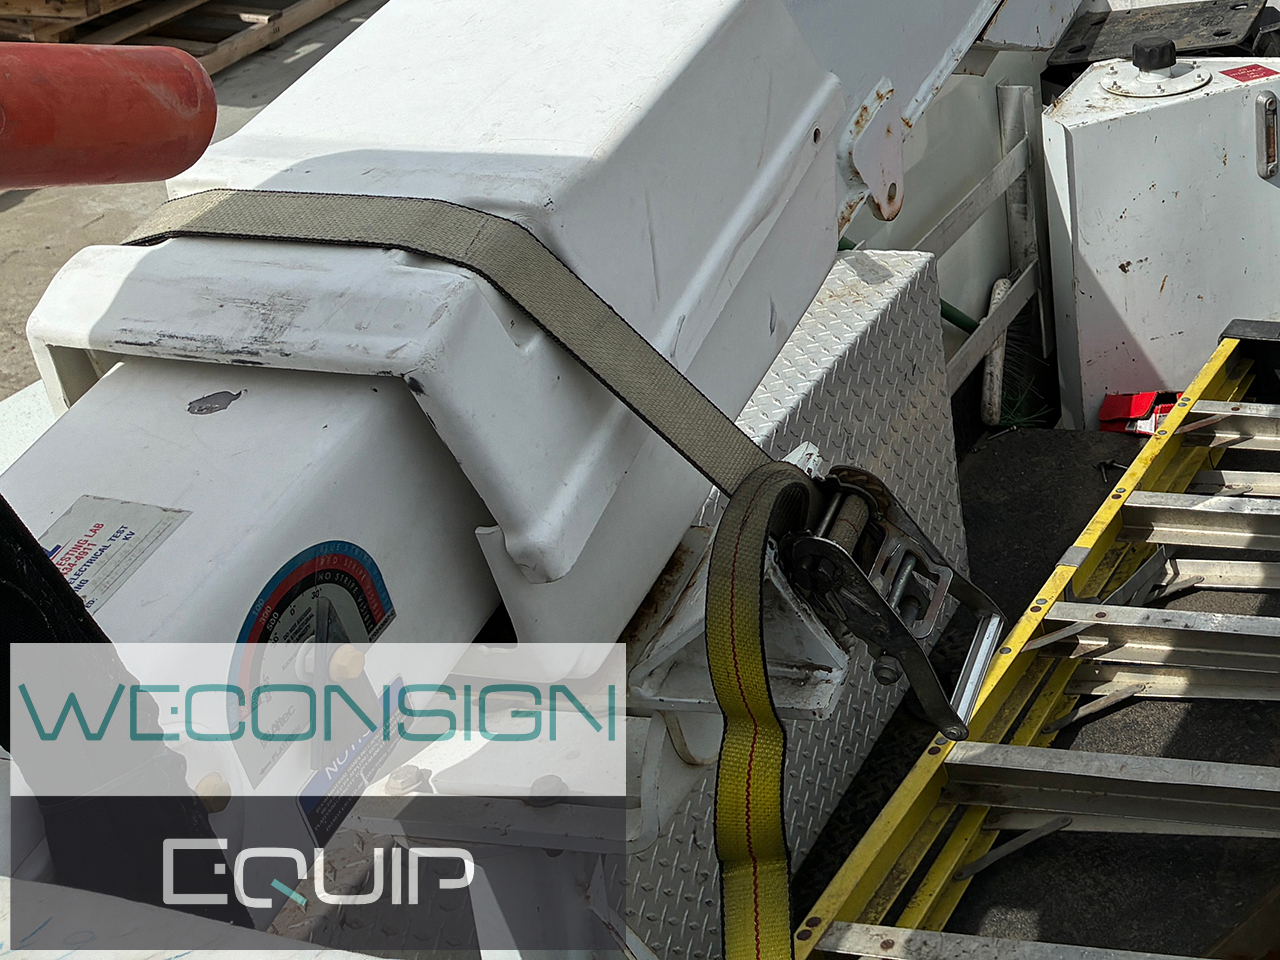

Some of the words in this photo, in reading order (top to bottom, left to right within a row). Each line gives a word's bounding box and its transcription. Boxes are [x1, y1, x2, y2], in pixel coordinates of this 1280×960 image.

[84, 522, 104, 538] LAB
[107, 524, 129, 543] TEST
[121, 530, 136, 542] KV
[317, 571, 332, 581] NO
[334, 572, 360, 598] STRIPE
[358, 596, 374, 632] VISIBLE
[266, 611, 280, 631] 500
